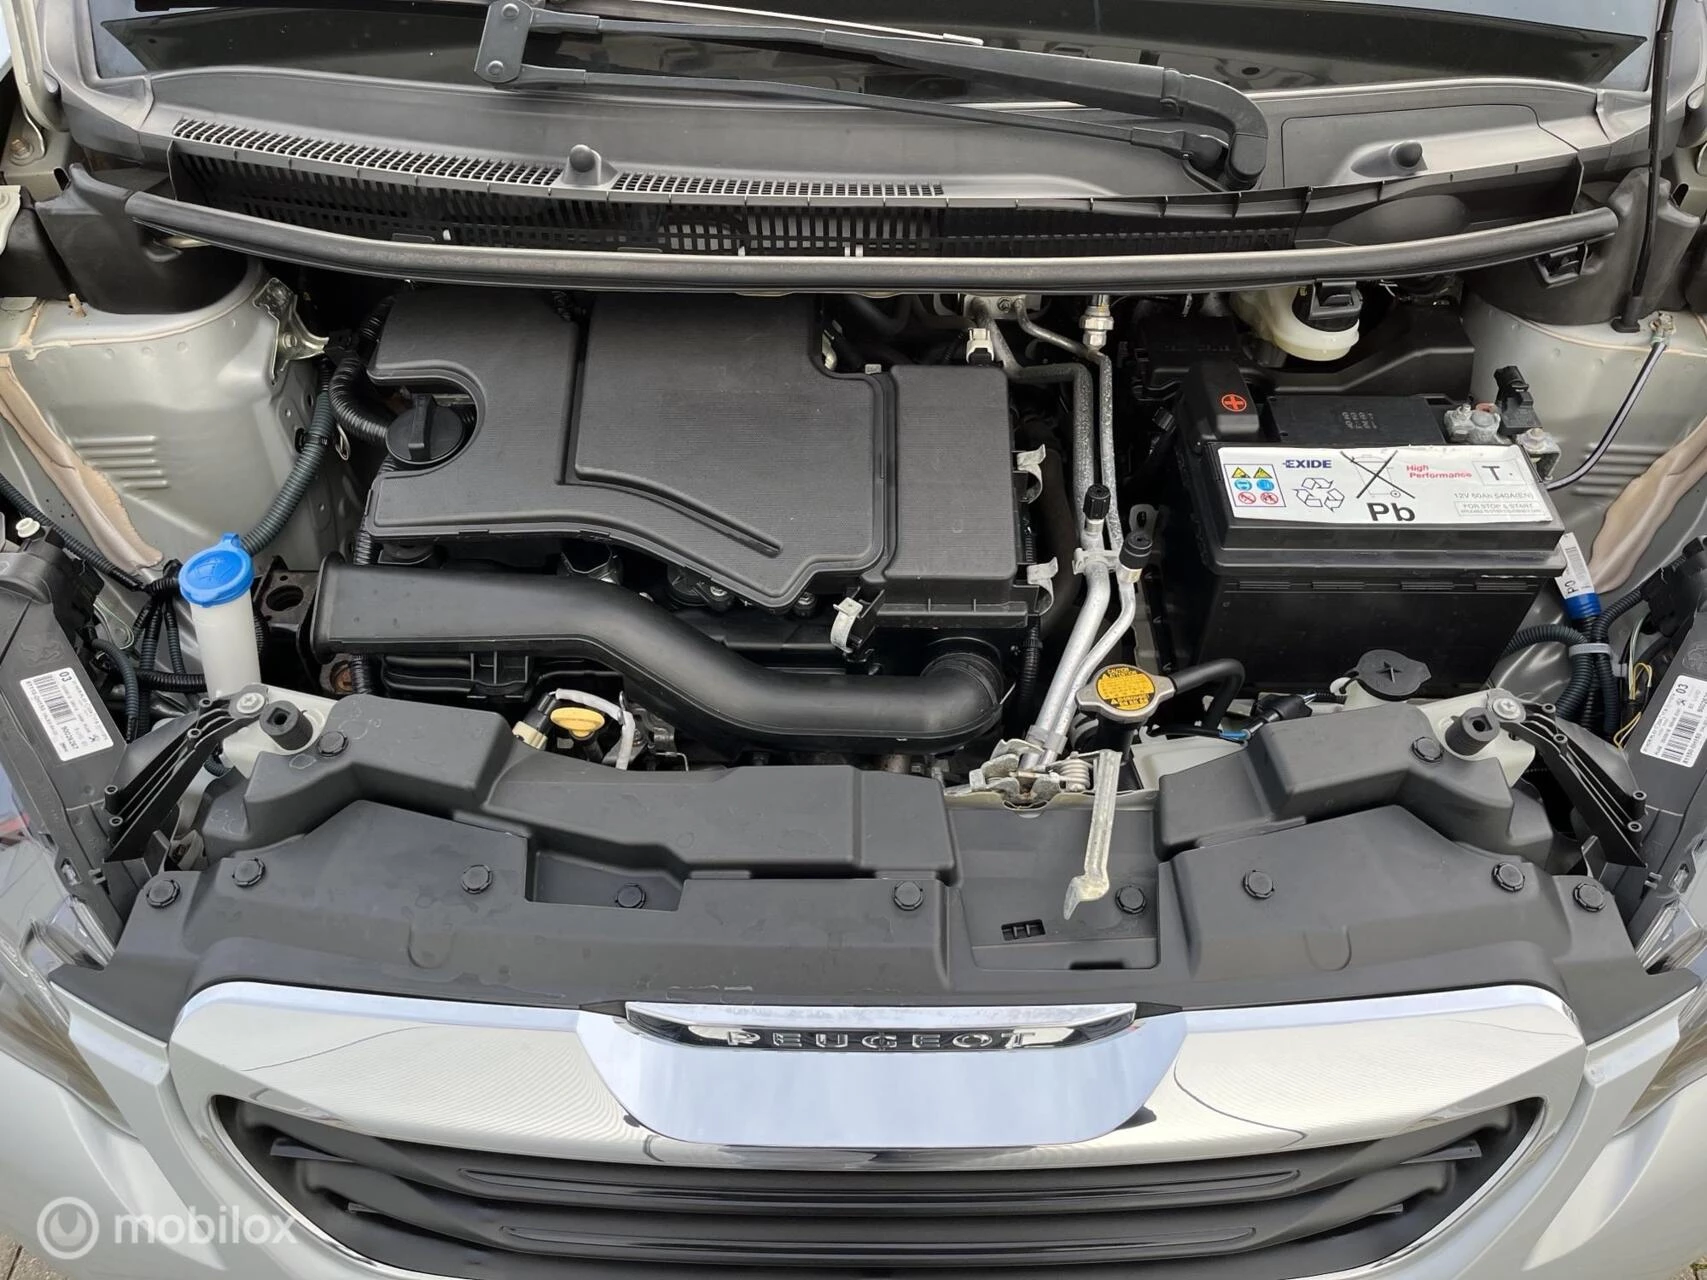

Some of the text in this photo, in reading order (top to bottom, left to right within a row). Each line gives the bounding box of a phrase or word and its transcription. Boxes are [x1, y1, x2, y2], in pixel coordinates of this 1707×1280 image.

[1283, 459, 1332, 469] EXIDE
[1406, 464, 1429, 472] High
[1481, 465, 1501, 481] T
[1366, 502, 1416, 522] Pb
[59, 671, 73, 683] 03
[1675, 683, 1689, 695] 03
[726, 1029, 1037, 1049] PEUGEOT
